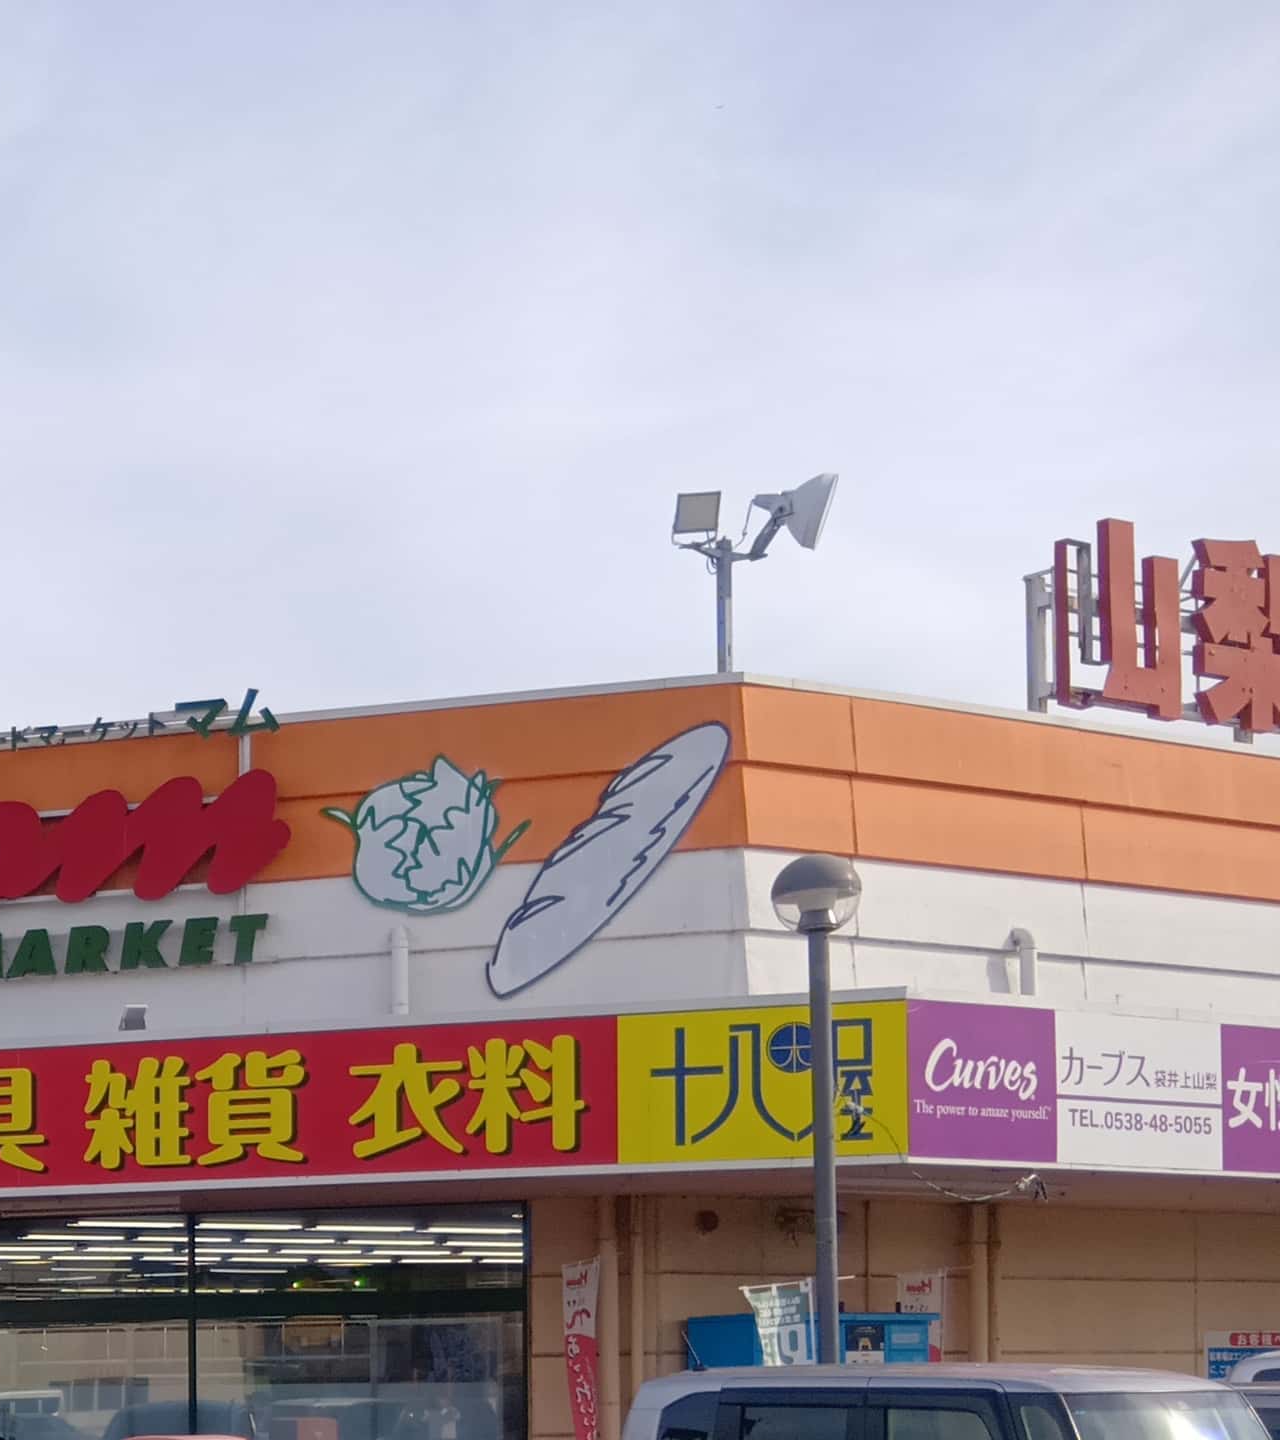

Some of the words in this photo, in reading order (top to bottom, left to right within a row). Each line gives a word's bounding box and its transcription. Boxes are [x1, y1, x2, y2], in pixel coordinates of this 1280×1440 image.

[175, 688, 281, 739] マム
[924, 1038, 1037, 1100] Curves
[1061, 1047, 1151, 1088] カーブス
[1154, 1070, 1218, 1090] 袋井上山梨
[83, 1048, 308, 1171] 雑貨
[349, 1033, 586, 1162] 衣料
[914, 1100, 935, 1113] The
[936, 1104, 966, 1118] power
[968, 1105, 978, 1116] to
[980, 1106, 1009, 1118] amaze
[1068, 1108, 1213, 1135] TEL.0538-48-5055
